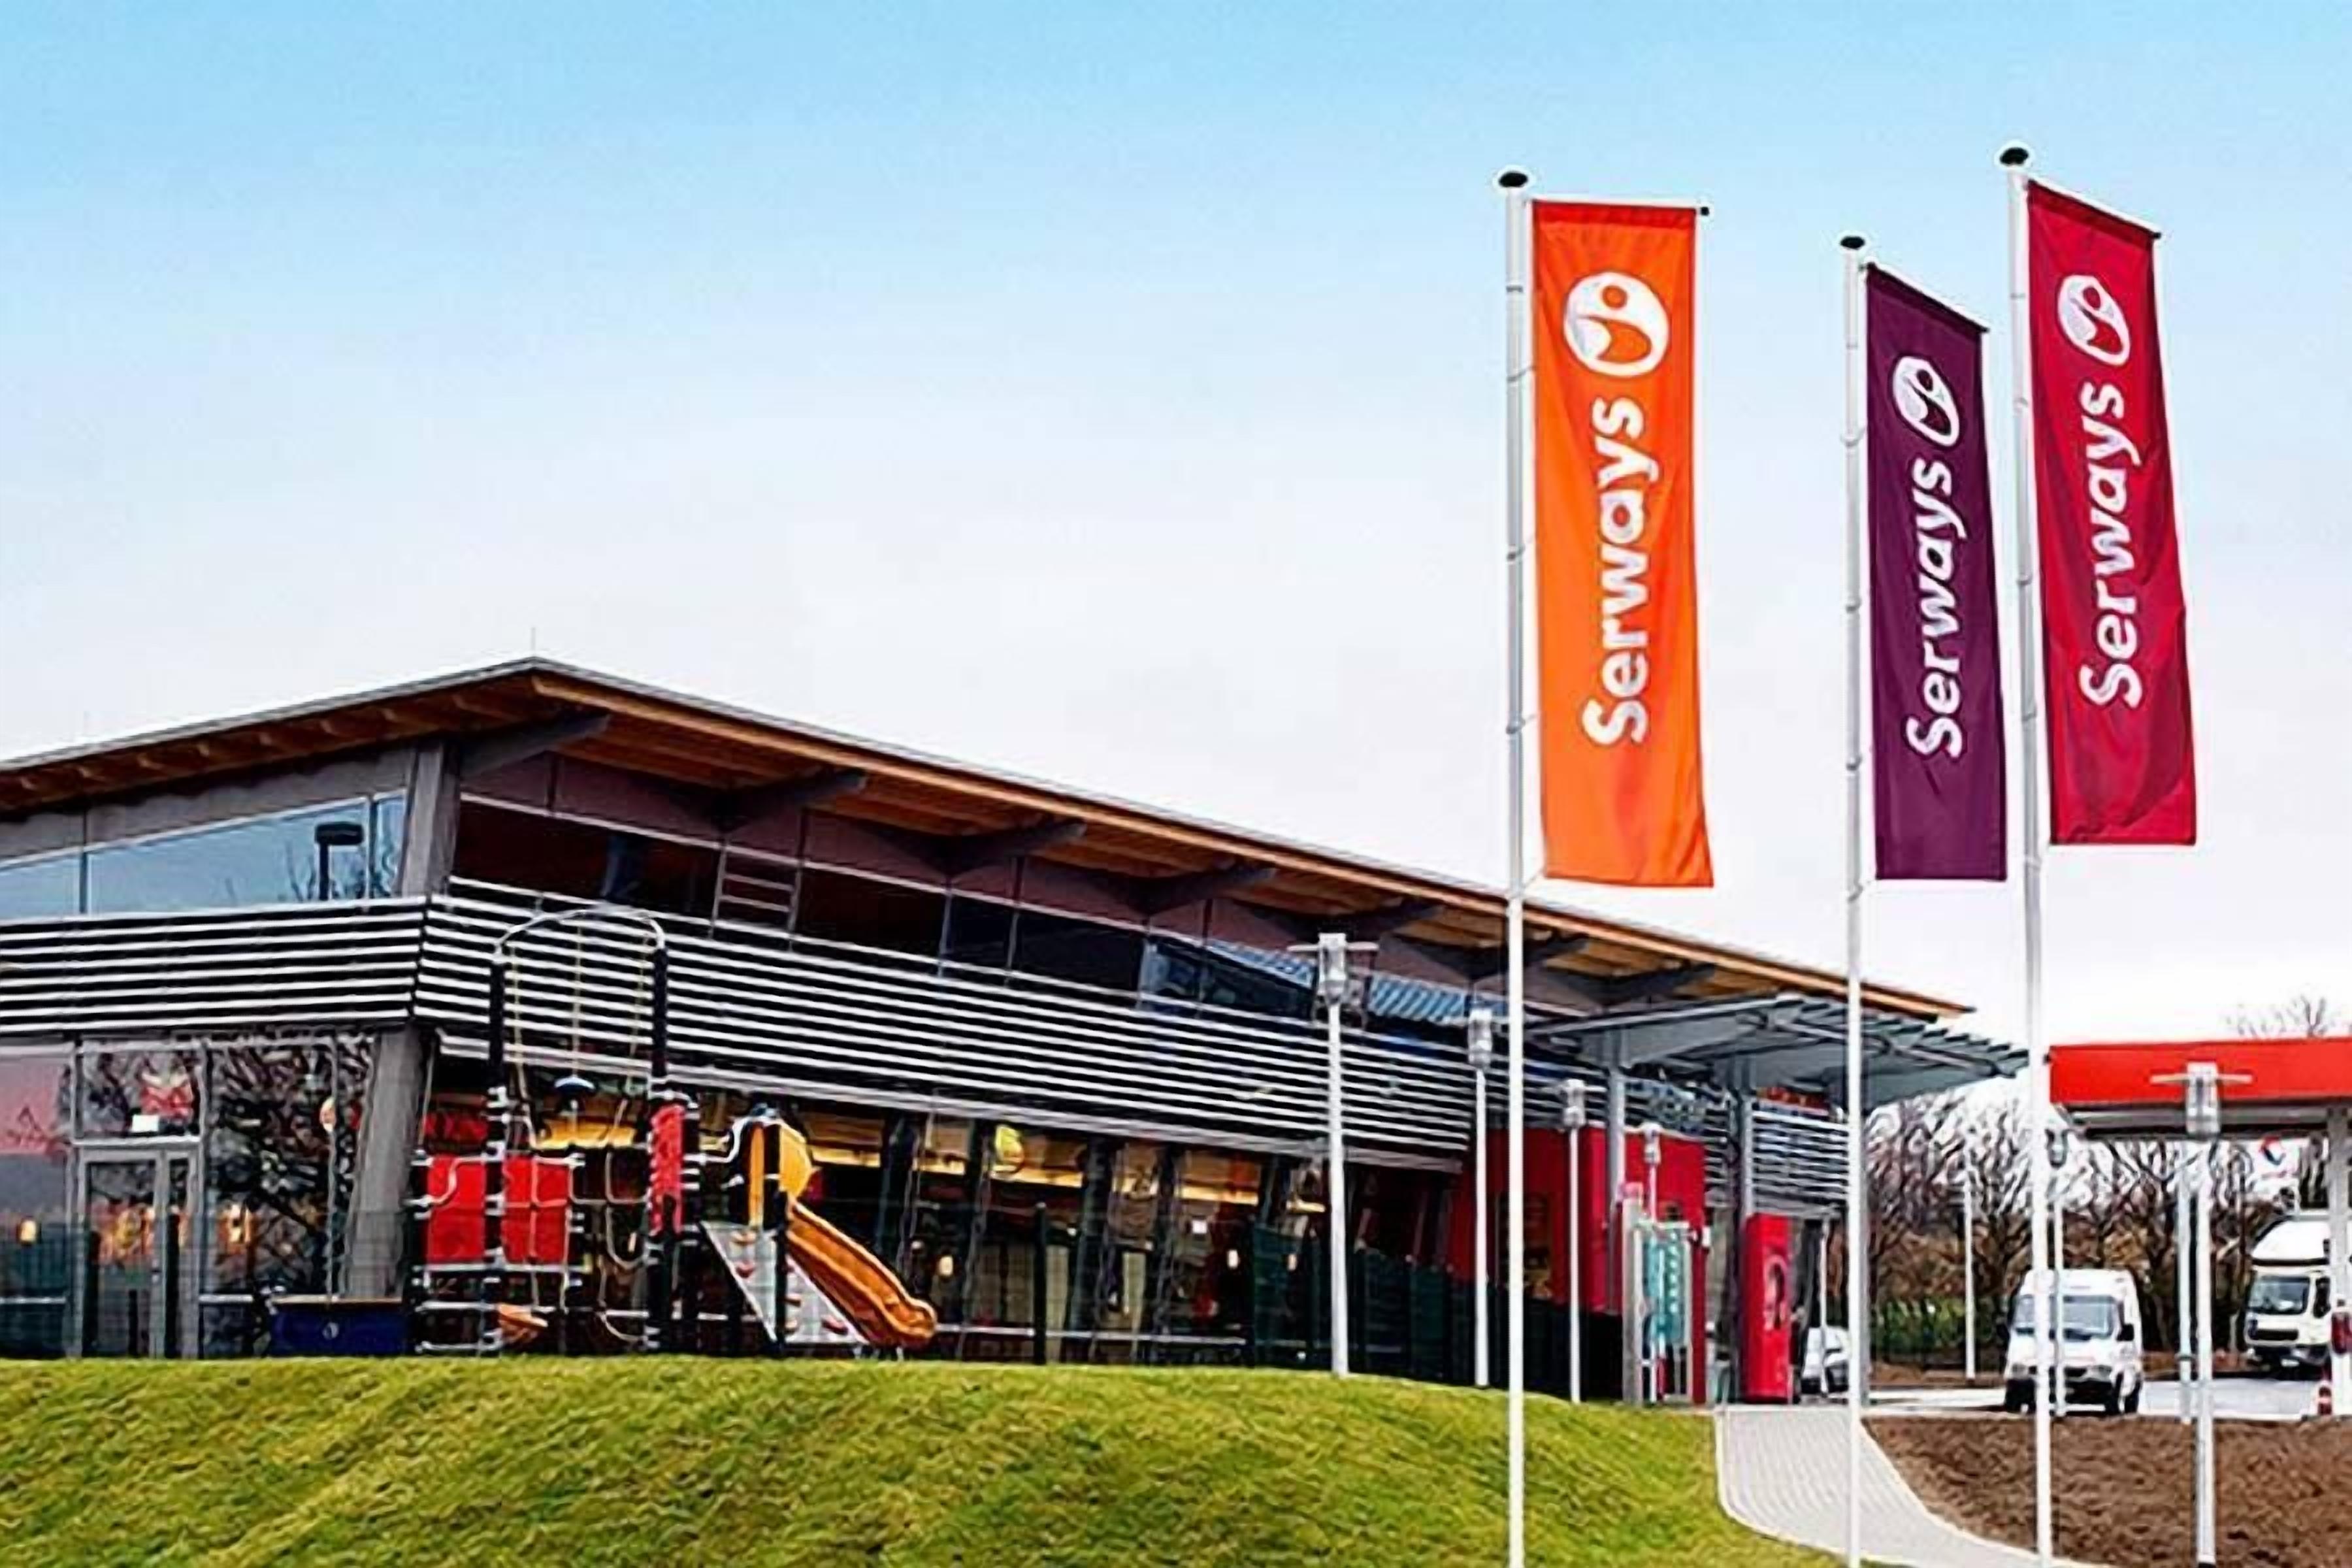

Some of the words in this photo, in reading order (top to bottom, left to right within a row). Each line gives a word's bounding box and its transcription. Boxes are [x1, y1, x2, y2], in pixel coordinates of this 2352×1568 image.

[1581, 397, 1660, 745] Serways
[1905, 457, 1968, 759] Serways
[2079, 382, 2142, 708] Serways
